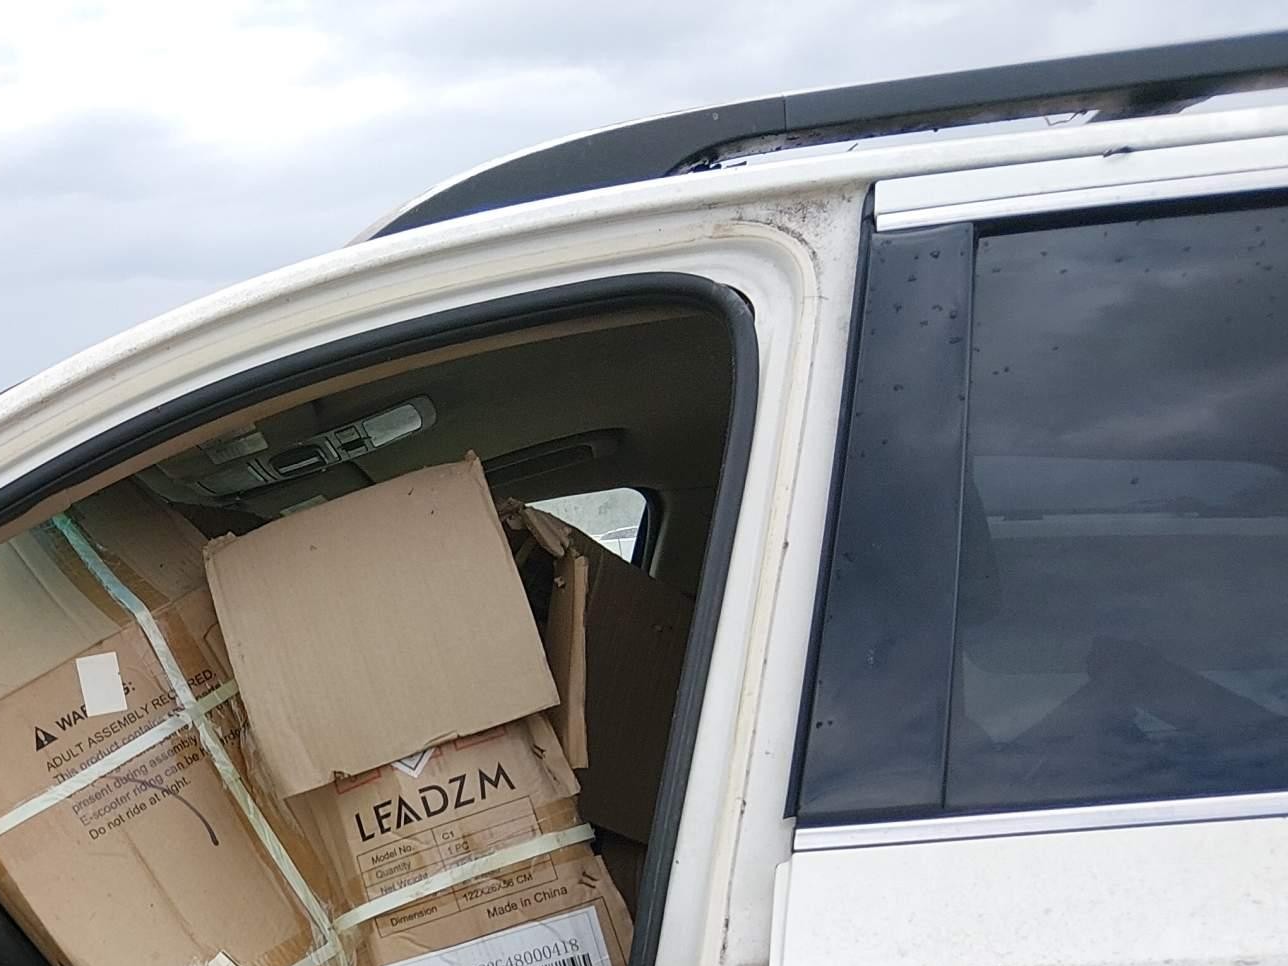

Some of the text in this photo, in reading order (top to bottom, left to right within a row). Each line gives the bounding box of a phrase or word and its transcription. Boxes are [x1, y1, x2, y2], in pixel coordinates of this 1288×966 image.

[47, 742, 84, 772] ADULT
[88, 704, 149, 748] ASSEMBLY
[80, 741, 120, 770] product
[72, 785, 113, 815] present
[113, 764, 149, 788] during
[149, 736, 198, 768] assembly
[80, 792, 133, 826] E-scooter
[133, 774, 164, 797] riding
[164, 762, 185, 777] can
[184, 752, 200, 766] be
[88, 776, 192, 840] Do not ride at night.
[355, 761, 516, 842] LEADZM
[441, 831, 455, 840] C1
[455, 841, 470, 851] PC
[371, 844, 415, 866] Model No.
[375, 862, 411, 879] Quantity
[516, 873, 533, 884] CM
[390, 905, 438, 927] Dimension
[486, 886, 568, 919] Made in China
